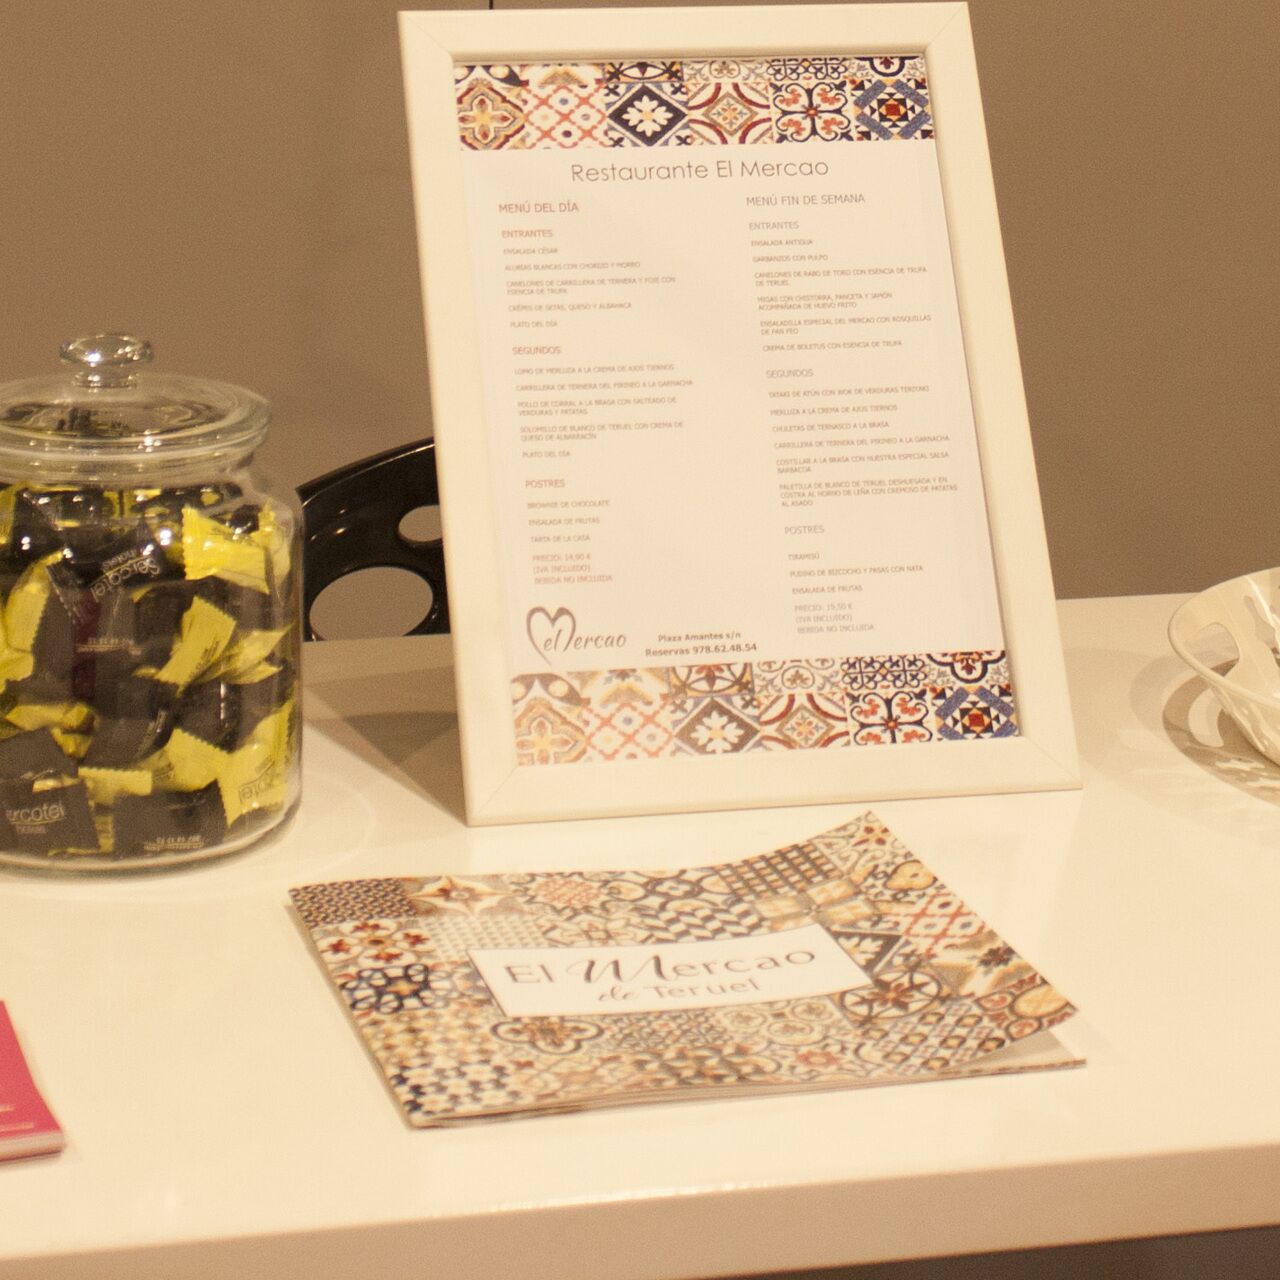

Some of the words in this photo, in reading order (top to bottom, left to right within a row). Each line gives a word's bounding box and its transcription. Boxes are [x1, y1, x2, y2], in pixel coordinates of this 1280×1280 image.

[571, 161, 709, 182] Restaurante
[716, 160, 734, 178] El
[740, 160, 829, 178] Mercao
[499, 200, 532, 213] MENÚ
[533, 202, 556, 213] DEL
[557, 200, 579, 212] DÍA
[746, 194, 779, 207] MENÚ
[780, 195, 800, 206] FIN
[802, 195, 819, 205] DE
[820, 194, 865, 205] SEMANA
[749, 221, 800, 231] ENTRANTES
[501, 229, 554, 238] ENTRANTES
[751, 239, 784, 247] ENSALADA
[784, 238, 813, 247] ANTIGUA
[503, 247, 537, 255] ENSALADA
[752, 254, 792, 263] GARBANZOS
[792, 254, 807, 262] CON
[754, 270, 792, 279] CANELONES
[832, 268, 852, 277] TORO
[852, 268, 867, 276] CON
[867, 267, 895, 276] ESENCIA
[906, 266, 927, 274] TRUFA
[779, 294, 794, 303] CON
[834, 292, 864, 301] PANCETA
[510, 320, 531, 328] PLATO
[531, 320, 545, 328] DEL
[545, 319, 558, 328] DÍA
[512, 345, 562, 355] SEGUNDOS
[763, 344, 786, 352] CREMA
[796, 342, 826, 351] BOLETUS
[826, 342, 842, 350] CON
[842, 341, 870, 349] ESENCIA
[881, 339, 902, 348] TRUFA
[514, 367, 534, 375] LOMO
[545, 366, 577, 374] MERLUZA
[592, 365, 616, 373] CREMA
[646, 363, 675, 372] TIERNOS
[766, 368, 814, 379] SEGUNDOS
[516, 383, 556, 392] CARRILLERA
[567, 382, 598, 391] TERNERA
[598, 381, 612, 390] DEL
[612, 380, 641, 389] PIRINEO
[770, 407, 801, 416] MERLUZA
[817, 406, 840, 415] CREMA
[869, 404, 898, 413] TIERNOS
[772, 424, 806, 433] CHULETAS
[816, 422, 852, 431] TERNASCO
[868, 420, 890, 429] BRASA
[774, 440, 814, 449] CARRILLERA
[825, 438, 855, 447] TERNERA
[856, 437, 869, 446] DEL
[869, 436, 898, 445] PIRINEO
[776, 457, 812, 466] COSTILLAR
[828, 455, 850, 464] BRASA
[850, 454, 866, 463] CON
[866, 453, 897, 462] NUESTRA
[897, 452, 928, 461] ESPECIAL
[928, 451, 949, 459] SALSA
[525, 478, 565, 489] POSTRES
[779, 482, 813, 491] PALETILLA
[824, 480, 851, 489] BLANCO
[887, 477, 932, 486] DESHUESADA
[780, 490, 807, 499] COSTRA
[816, 489, 842, 498] HORNO
[852, 486, 871, 496] LEÑA
[871, 487, 886, 496] CON
[790, 499, 813, 508] ASADO
[528, 518, 563, 527] ENSALADA
[574, 517, 600, 526] FRUTAS
[784, 525, 825, 535] POSTRES
[530, 535, 551, 543] TARTA
[572, 534, 591, 542] CASA
[792, 586, 826, 594] ENSALADA
[837, 584, 863, 593] FRUTAS
[797, 625, 825, 634] BEBIDA
[839, 623, 874, 632] INCLUIDA
[658, 633, 683, 643] Plaza
[684, 631, 724, 642] Amantes
[725, 631, 741, 640] s/n
[645, 645, 691, 657] Reservas
[692, 642, 757, 655] 978.62.48.54
[504, 963, 555, 984] El
[566, 950, 816, 984] Mercao
[598, 985, 638, 1002] de
[643, 977, 761, 999] Teruel
